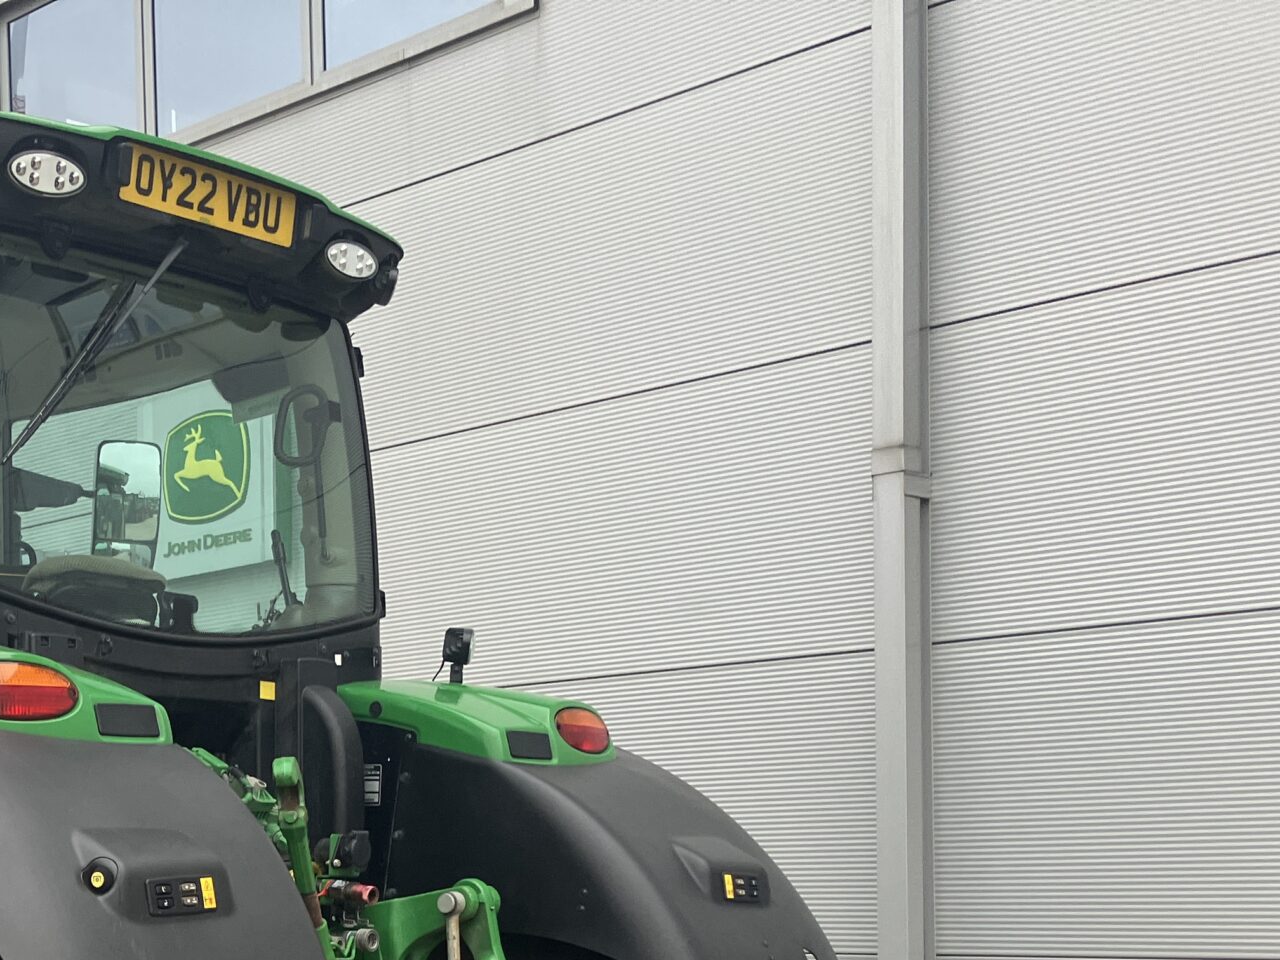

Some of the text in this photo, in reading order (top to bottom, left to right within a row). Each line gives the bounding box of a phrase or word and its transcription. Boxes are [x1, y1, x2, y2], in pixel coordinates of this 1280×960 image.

[135, 154, 282, 234] OY22 VBU
[163, 528, 253, 558] JOHN DEERE
